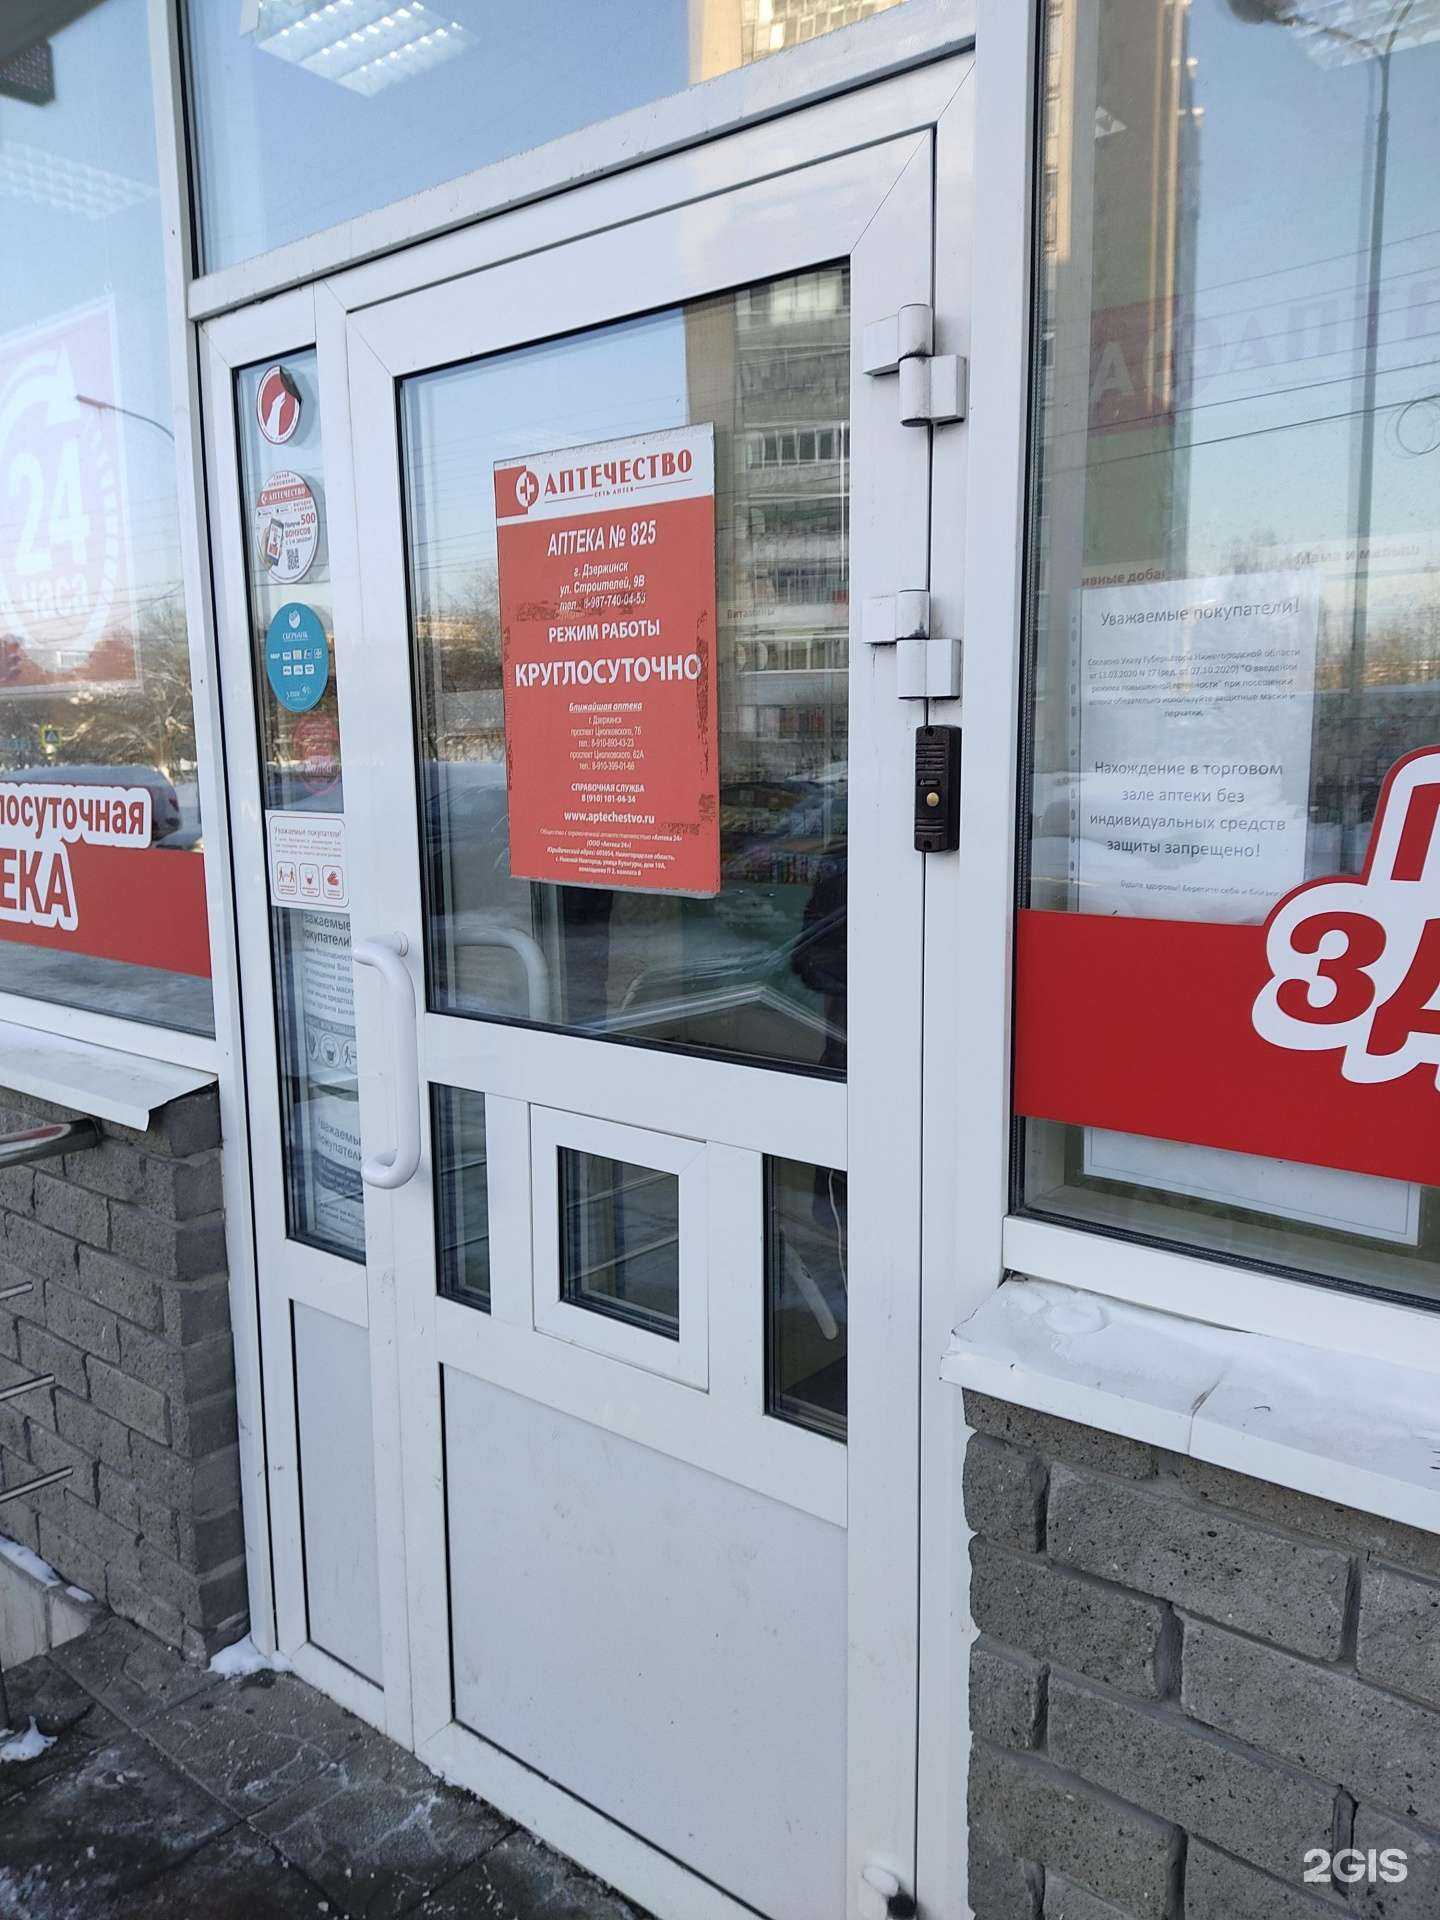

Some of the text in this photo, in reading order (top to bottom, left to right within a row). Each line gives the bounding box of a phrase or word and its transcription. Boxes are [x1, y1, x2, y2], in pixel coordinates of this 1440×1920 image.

[544, 449, 693, 496] АПТЕЧЕСТВО
[8, 440, 91, 575] 24
[301, 512, 316, 525] 500
[547, 519, 657, 557] АПТЕКА № 825
[582, 561, 629, 579] Дзержинск
[559, 574, 645, 598] ул. Строителей, 9В
[1101, 599, 1303, 626] Уважаемые покупатели!
[549, 619, 660, 643] РЕЖИМ РАБОТЫ
[515, 654, 702, 687] КРУГЛОСУТОЧНО
[568, 701, 643, 713] Ближайшая аптека
[1095, 760, 1283, 778] Нахождение в торговом
[571, 783, 645, 793] СПРАВОЧНАЯ СЛУЖБА
[1122, 787, 1245, 803] зале аптеки без
[0, 795, 145, 840] осуточная
[564, 811, 655, 824] www.aptechestvo.ru
[1090, 814, 1286, 832] индивидуальных средств
[1107, 840, 1261, 859] защиты запрещено!
[0, 849, 72, 918] ЕКА
[304, 912, 351, 932] важаемые
[304, 929, 352, 948] окупатели!
[319, 1118, 361, 1148] важаемы
